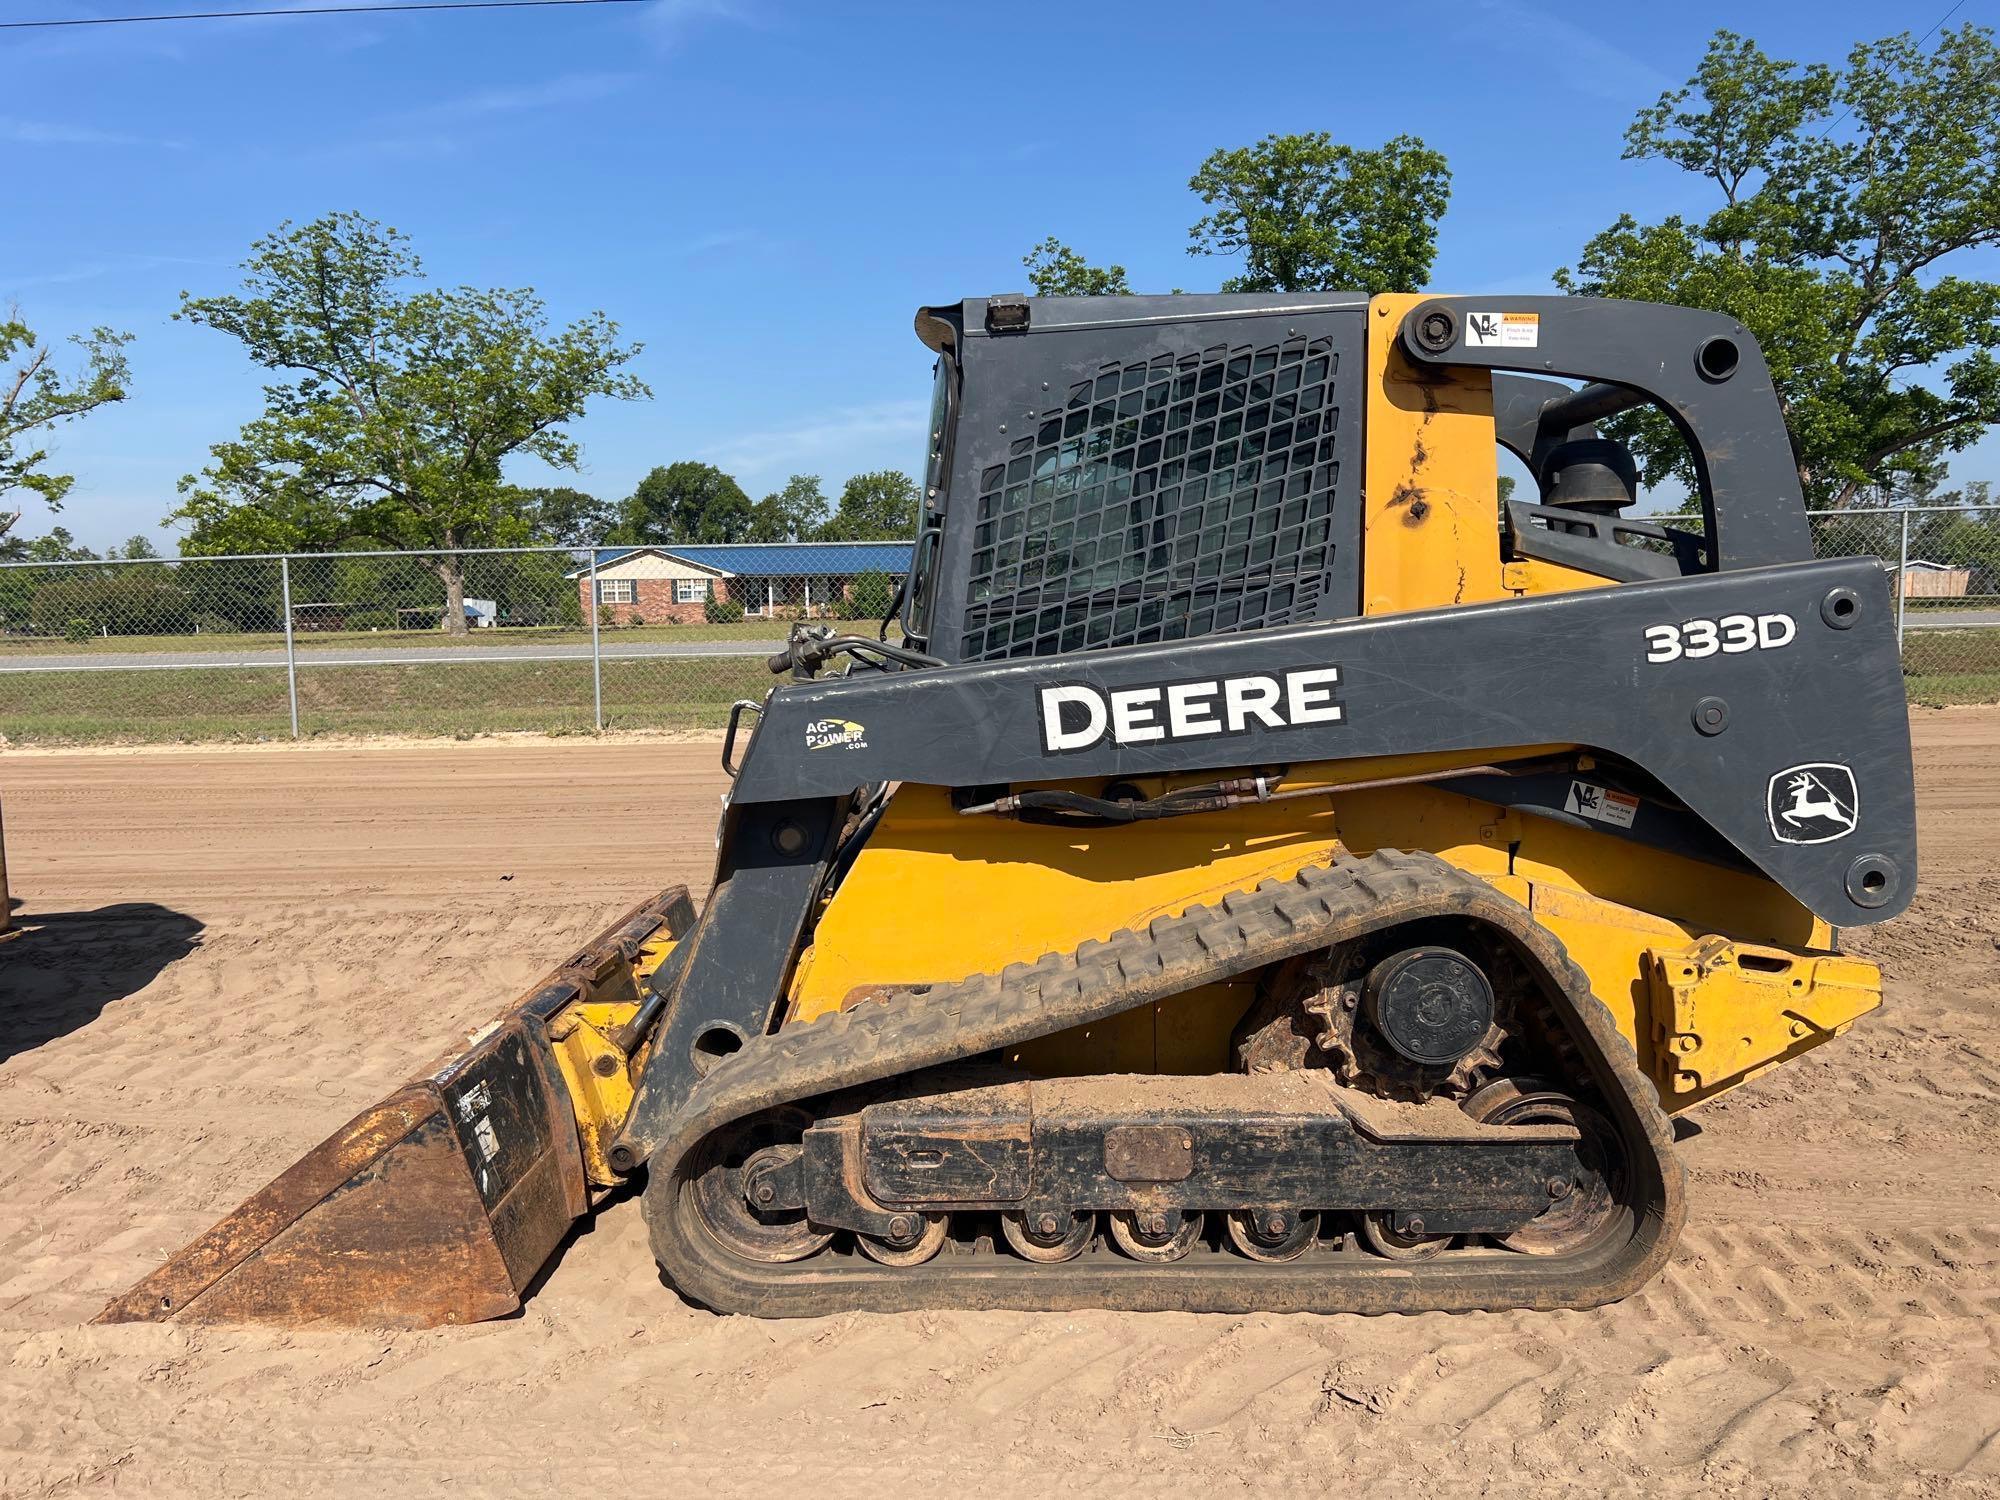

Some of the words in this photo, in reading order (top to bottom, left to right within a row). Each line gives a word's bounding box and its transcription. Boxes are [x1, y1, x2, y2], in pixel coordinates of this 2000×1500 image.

[1645, 613, 1796, 663] 333D
[1041, 668, 1341, 751] DEERE
[806, 721, 835, 733] AG-
[806, 731, 863, 747] POWER
[845, 742, 868, 750] .COM
